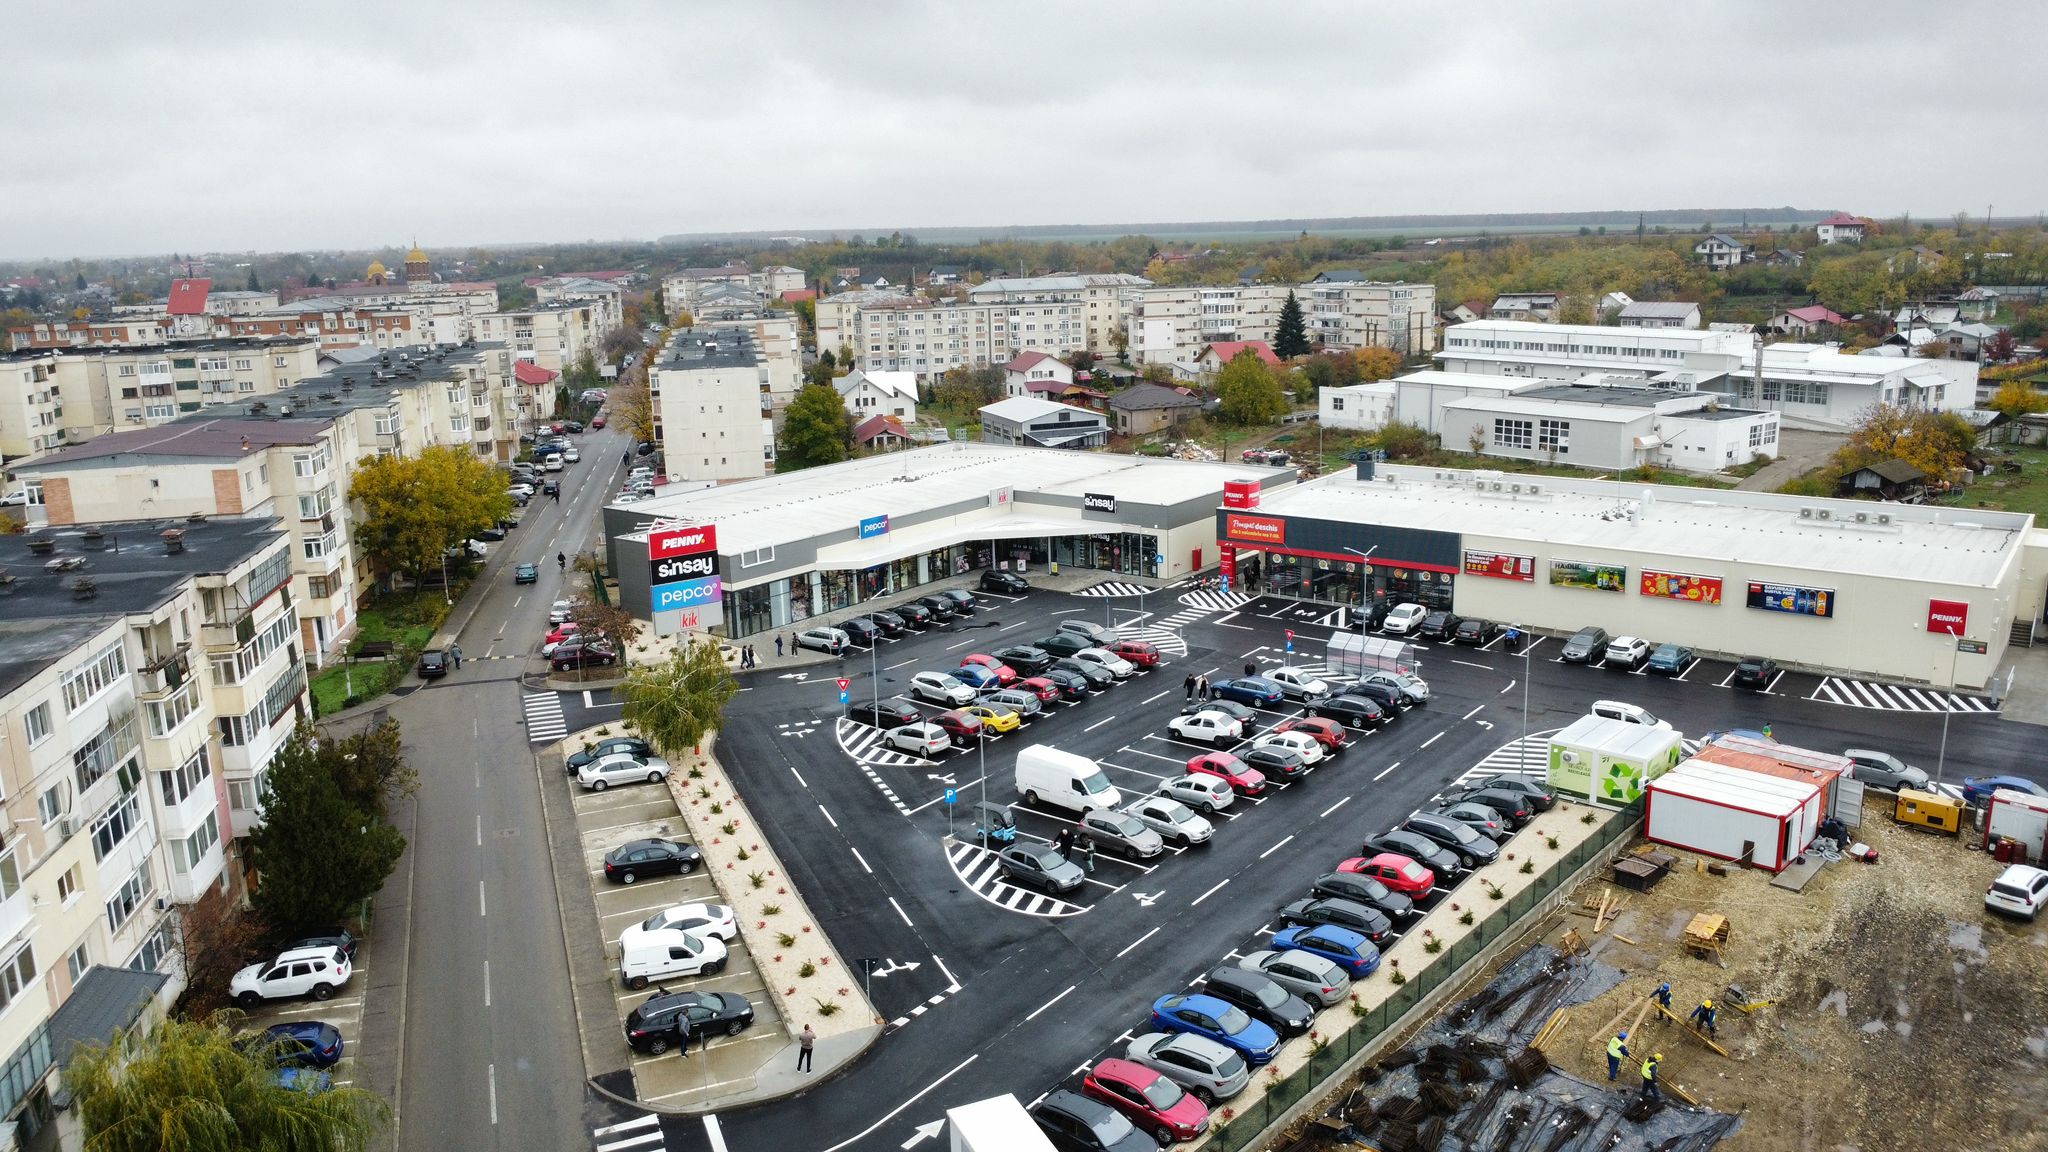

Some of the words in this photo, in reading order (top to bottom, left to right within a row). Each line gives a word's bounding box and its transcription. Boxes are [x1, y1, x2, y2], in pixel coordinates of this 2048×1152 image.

[1084, 495, 1114, 511] sinsay
[1254, 523, 1278, 532] deschis
[658, 557, 713, 578] sinsay
[681, 612, 698, 628] kik
[946, 789, 954, 799] P
